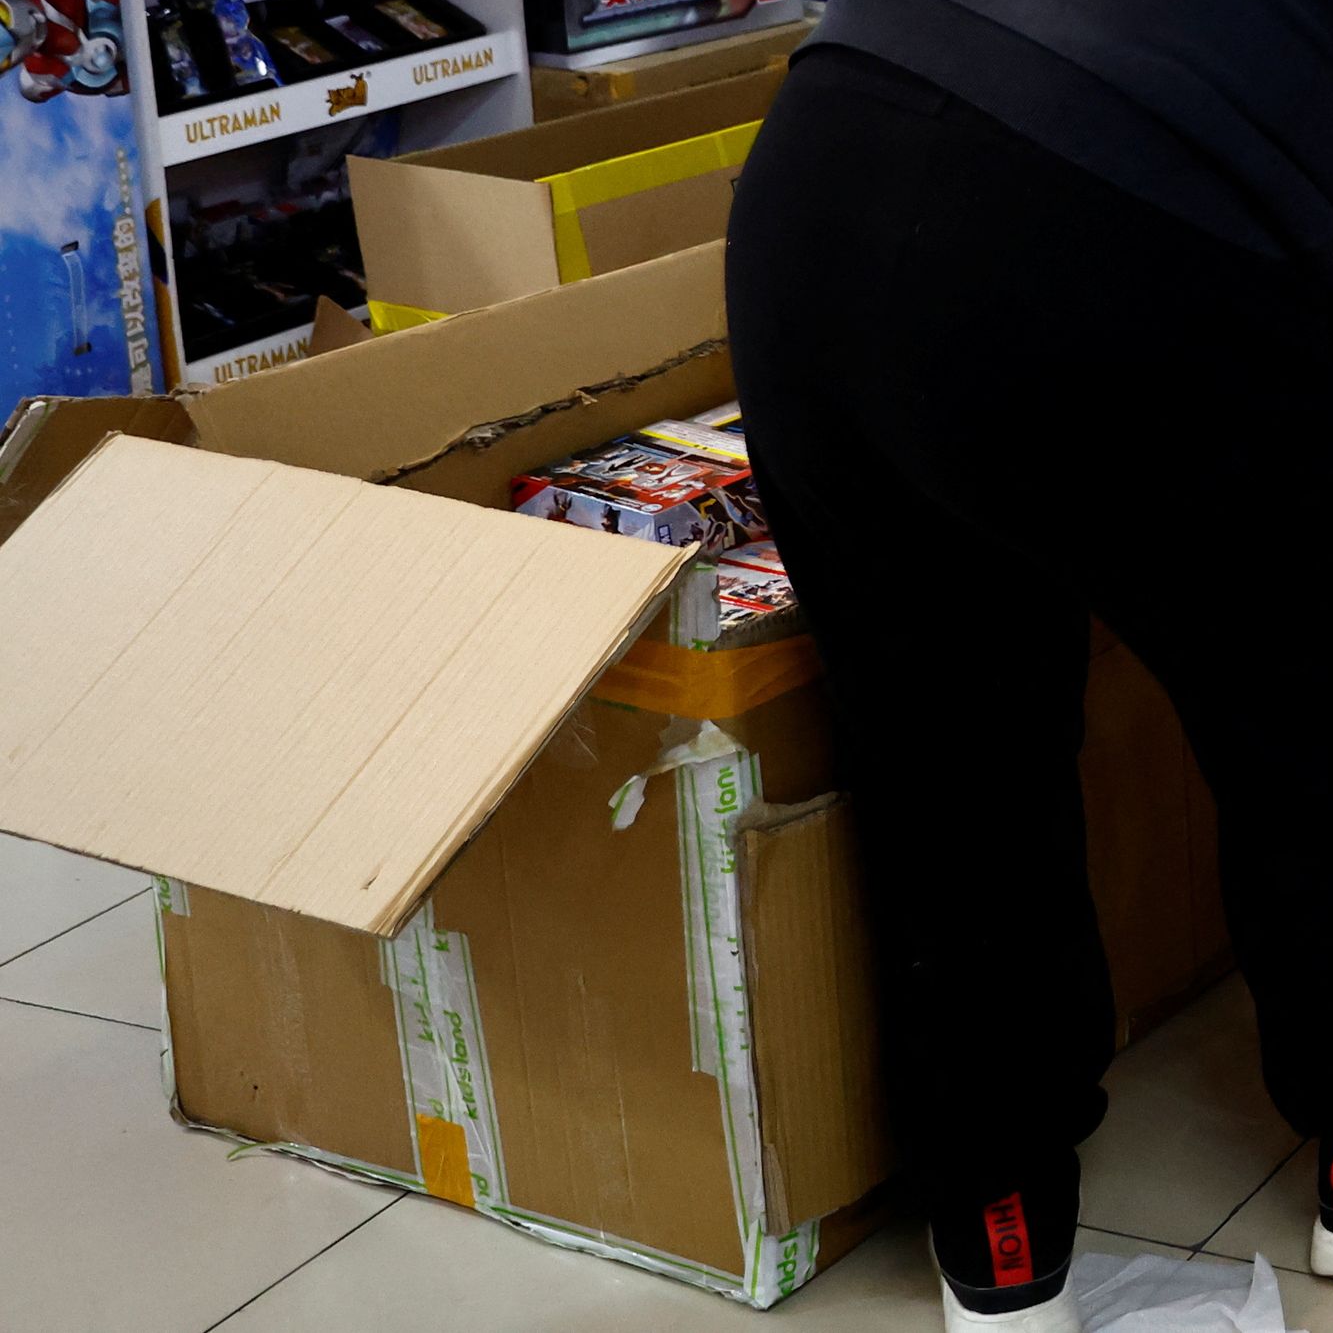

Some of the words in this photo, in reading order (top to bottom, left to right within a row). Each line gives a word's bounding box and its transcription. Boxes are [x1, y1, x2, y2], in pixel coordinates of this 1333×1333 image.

[184, 102, 282, 144] ULTRAMAN
[412, 47, 494, 86] ULTRAMAN
[443, 1009, 478, 1120] kidsland
